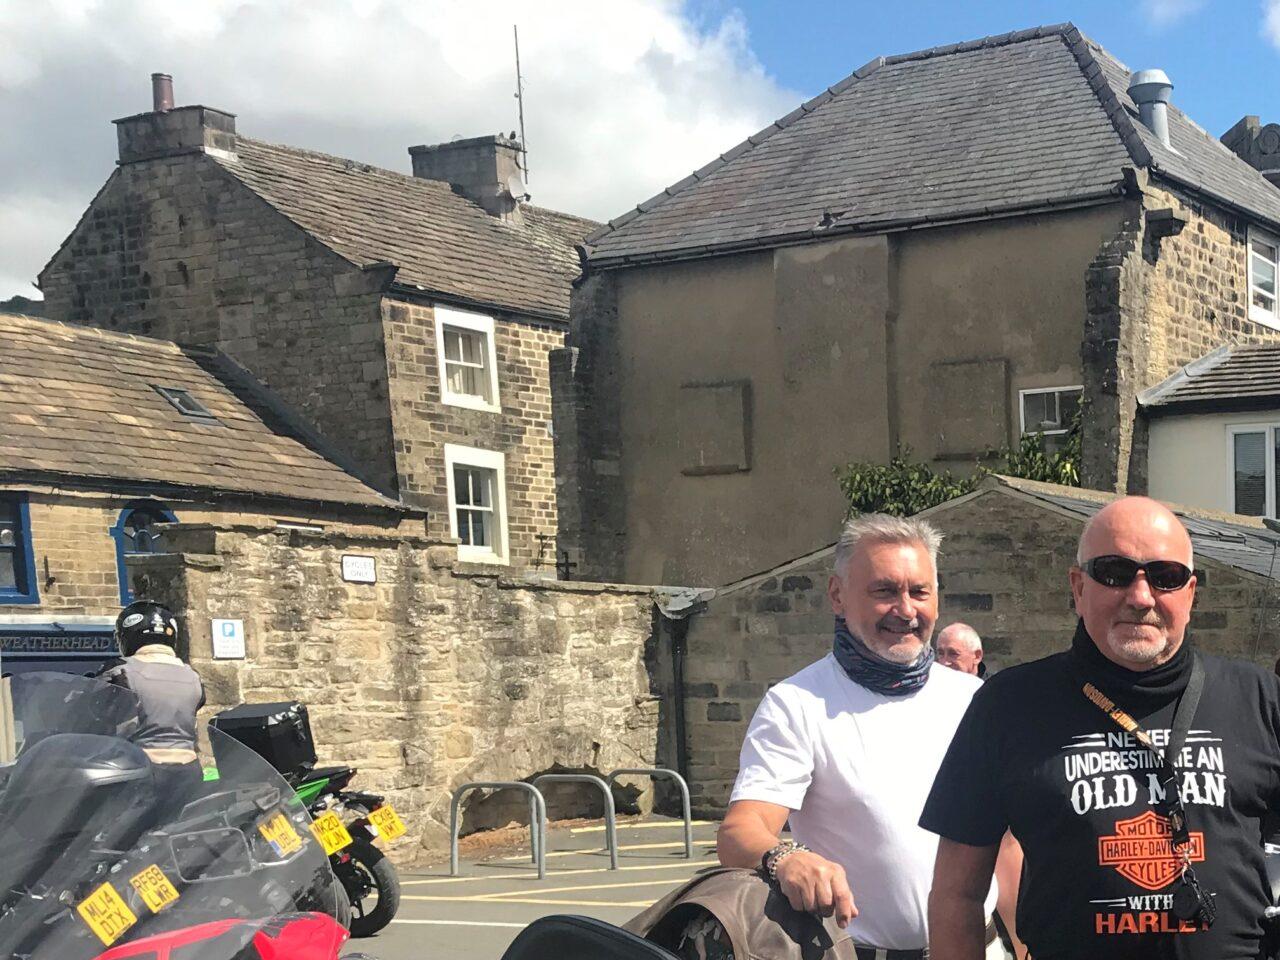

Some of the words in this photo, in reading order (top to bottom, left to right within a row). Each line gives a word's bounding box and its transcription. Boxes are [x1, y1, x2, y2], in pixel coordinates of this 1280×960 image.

[0, 636, 111, 649] WEATHERHEAD
[1064, 747, 1194, 782] UNDERESTIME
[1197, 747, 1225, 772] AN
[1070, 773, 1138, 815] OLD
[1106, 837, 1198, 858] HARLEY-DAVIN
[132, 866, 164, 892] RF68
[1127, 860, 1178, 884] CYCLES
[84, 889, 116, 922] ML14
[1127, 894, 1174, 911] WITH
[100, 907, 129, 937] DTX
[1095, 912, 1209, 934] HARLE
